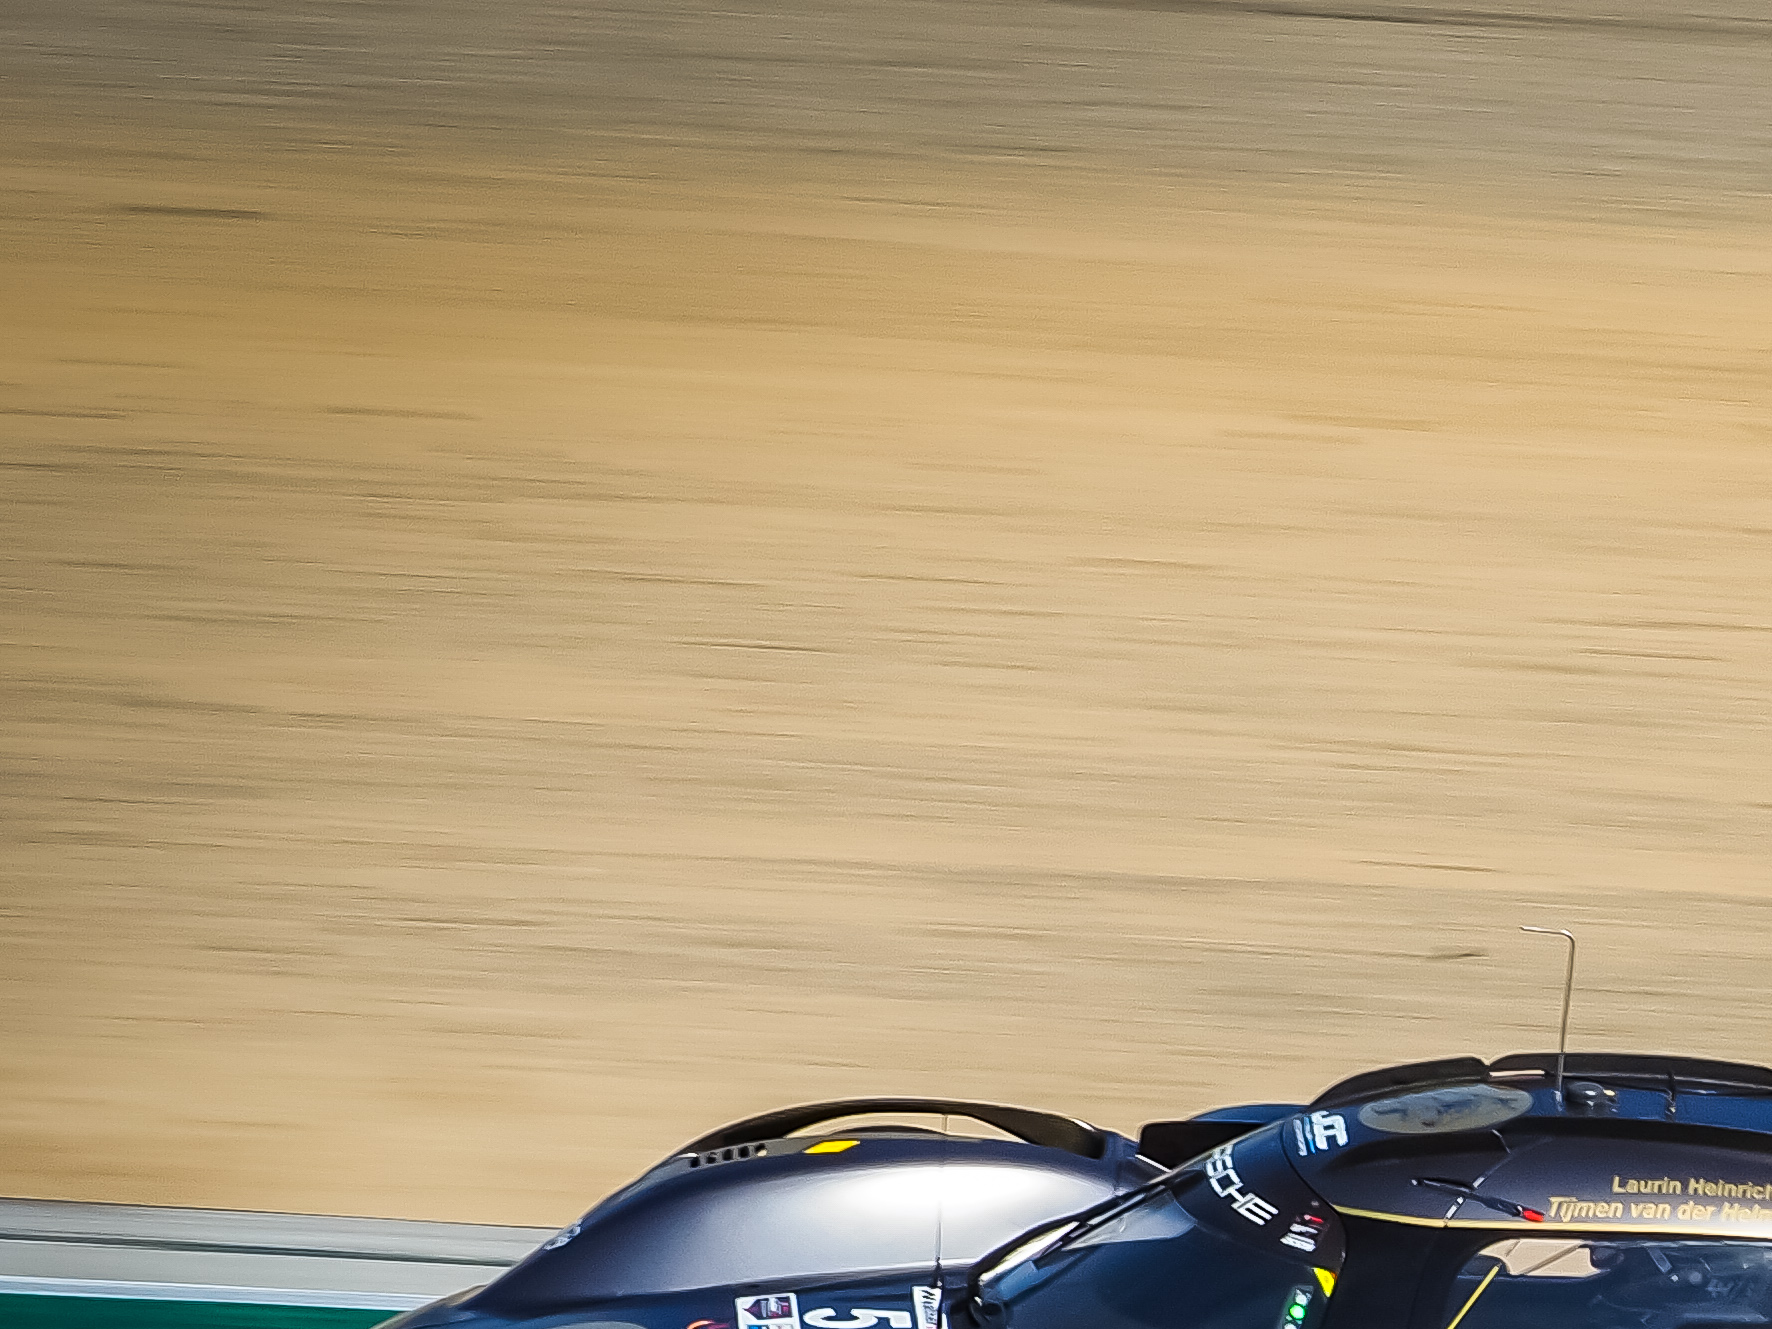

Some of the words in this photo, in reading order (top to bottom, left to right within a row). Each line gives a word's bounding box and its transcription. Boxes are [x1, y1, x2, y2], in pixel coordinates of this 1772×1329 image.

[1612, 1175, 1682, 1195] Laurin
[1630, 1202, 1671, 1219] van
[1677, 1200, 1716, 1220] der
[803, 1308, 912, 1329] 5
